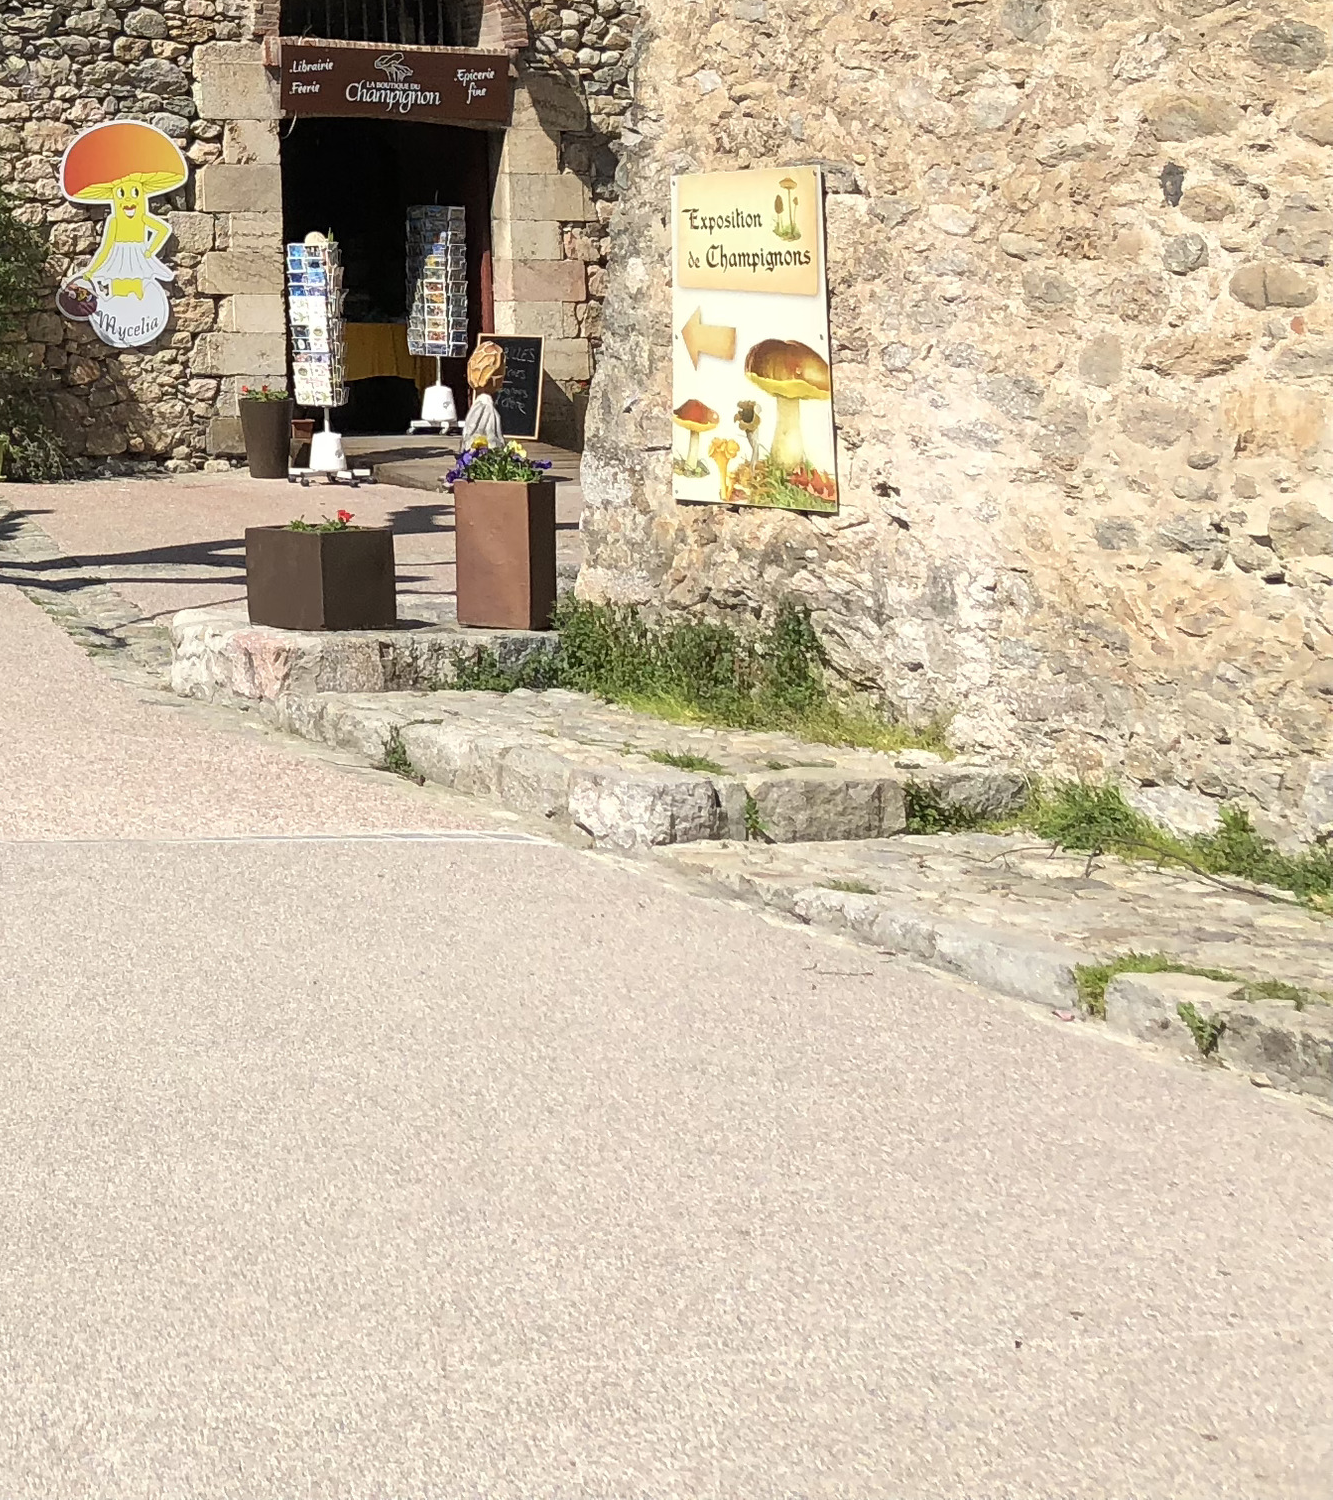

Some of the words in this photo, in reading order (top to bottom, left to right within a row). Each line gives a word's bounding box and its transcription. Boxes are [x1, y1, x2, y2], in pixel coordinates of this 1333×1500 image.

[345, 79, 442, 114] Champignon
[376, 81, 410, 90] BOUTIQUE
[410, 82, 421, 90] DU
[466, 82, 487, 104] fine
[681, 207, 763, 235] Exposition
[688, 251, 701, 268] de
[705, 244, 811, 273] Champignons
[94, 310, 159, 341] Mycelia
